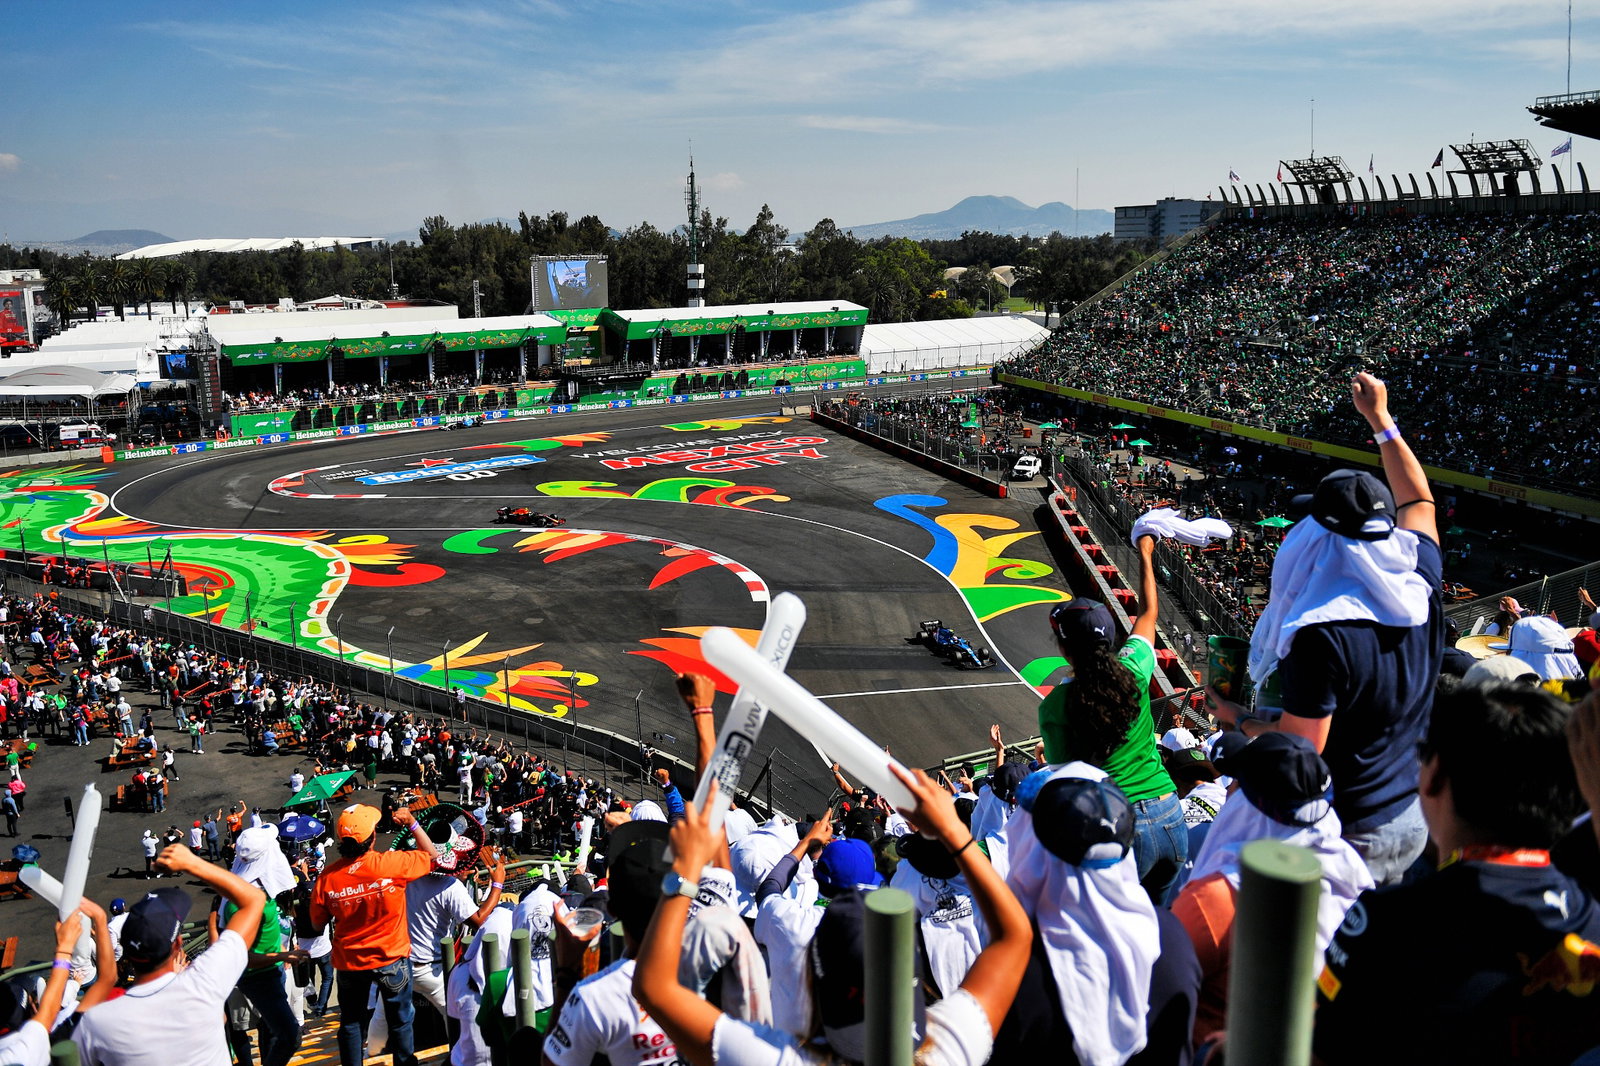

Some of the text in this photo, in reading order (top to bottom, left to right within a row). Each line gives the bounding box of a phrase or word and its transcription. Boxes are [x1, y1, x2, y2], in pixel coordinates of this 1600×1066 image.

[636, 397, 664, 406] Heineken
[693, 393, 719, 401] Heineken
[577, 402, 606, 411] Heineken
[513, 408, 545, 417] Heineken
[373, 420, 409, 431] Heineken
[1211, 421, 1232, 432] PIRELLI
[296, 429, 334, 440] Heineken
[213, 438, 254, 449] Heineken
[570, 430, 784, 458] WELCOME BACK
[1287, 437, 1312, 451] PIRELLI
[125, 448, 168, 459] Heineken
[600, 436, 829, 470] MEXICO
[685, 447, 829, 473] CITY
[369, 456, 532, 482] Heineken
[446, 469, 498, 481] 0.0
[1488, 482, 1526, 498] PIRELLI
[328, 884, 365, 899] Red Bull
[331, 885, 396, 908] RACING
